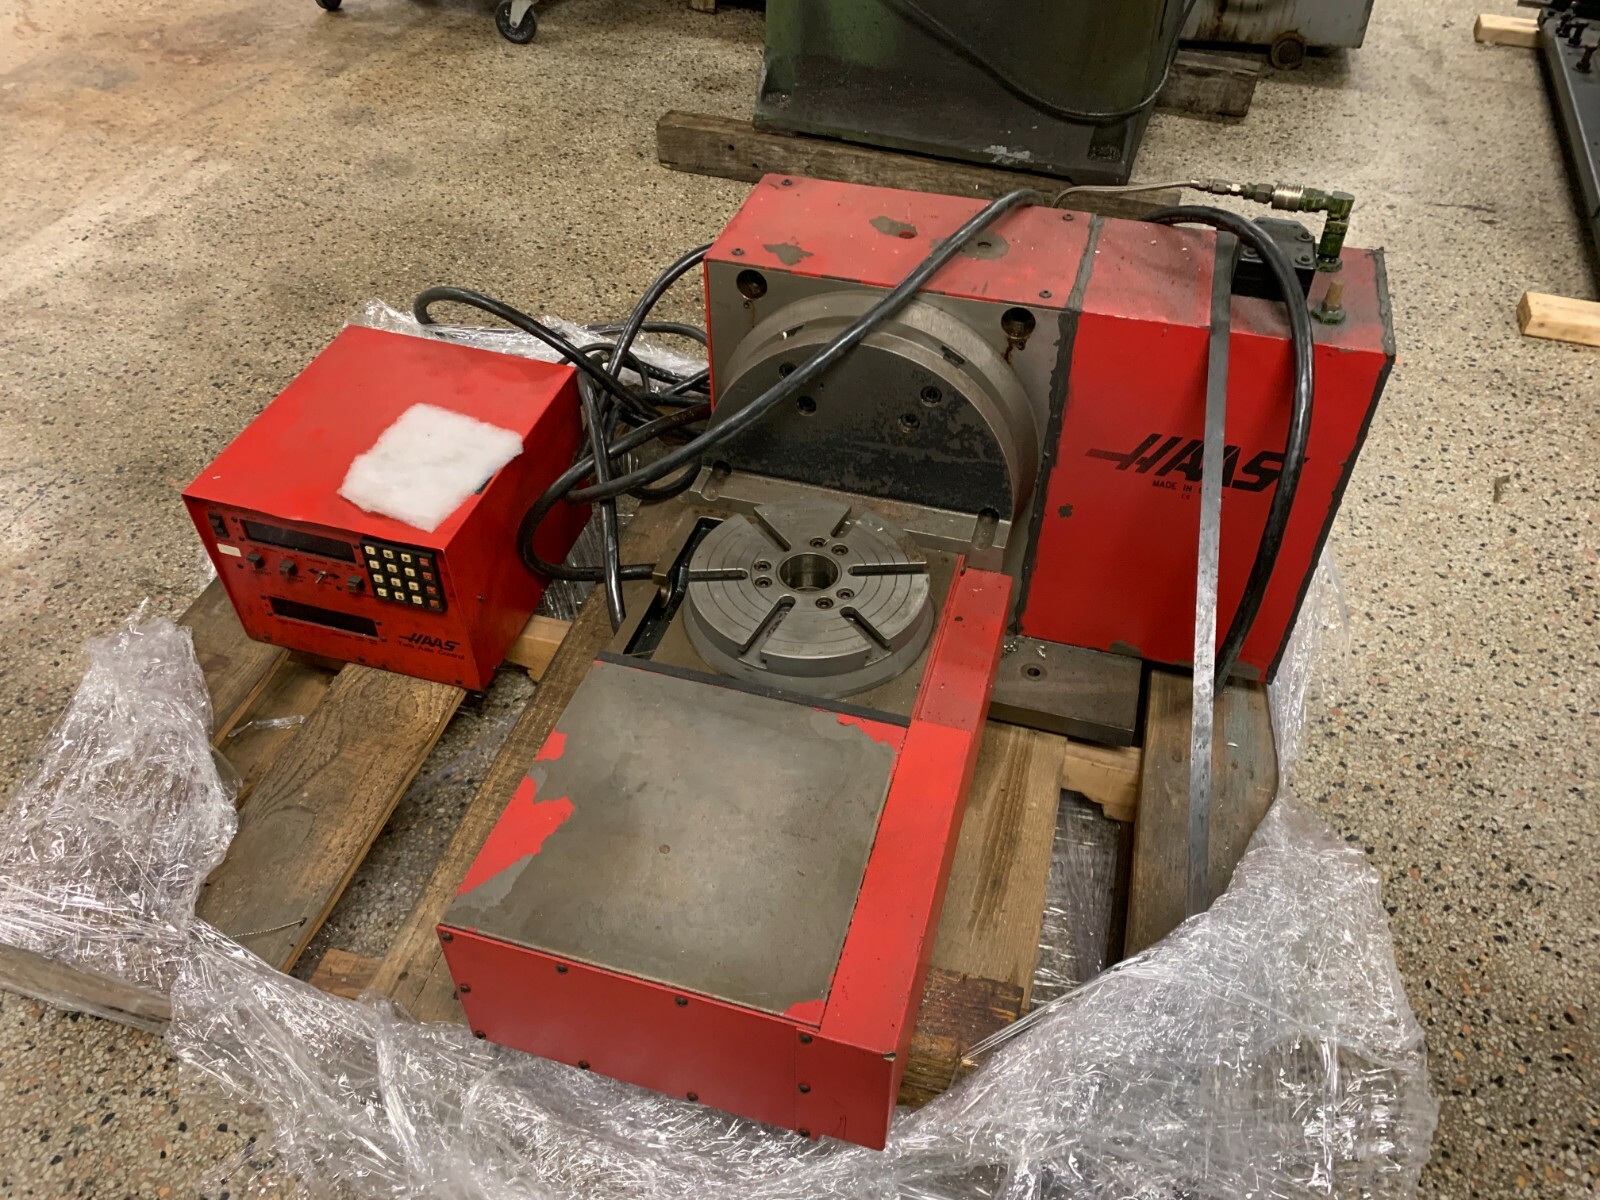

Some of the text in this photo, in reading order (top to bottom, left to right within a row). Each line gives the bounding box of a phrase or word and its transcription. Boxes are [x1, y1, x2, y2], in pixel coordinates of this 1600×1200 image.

[1085, 433, 1309, 492] HAAS
[1152, 480, 1192, 492] MADE IN
[398, 633, 461, 651] HAAS
